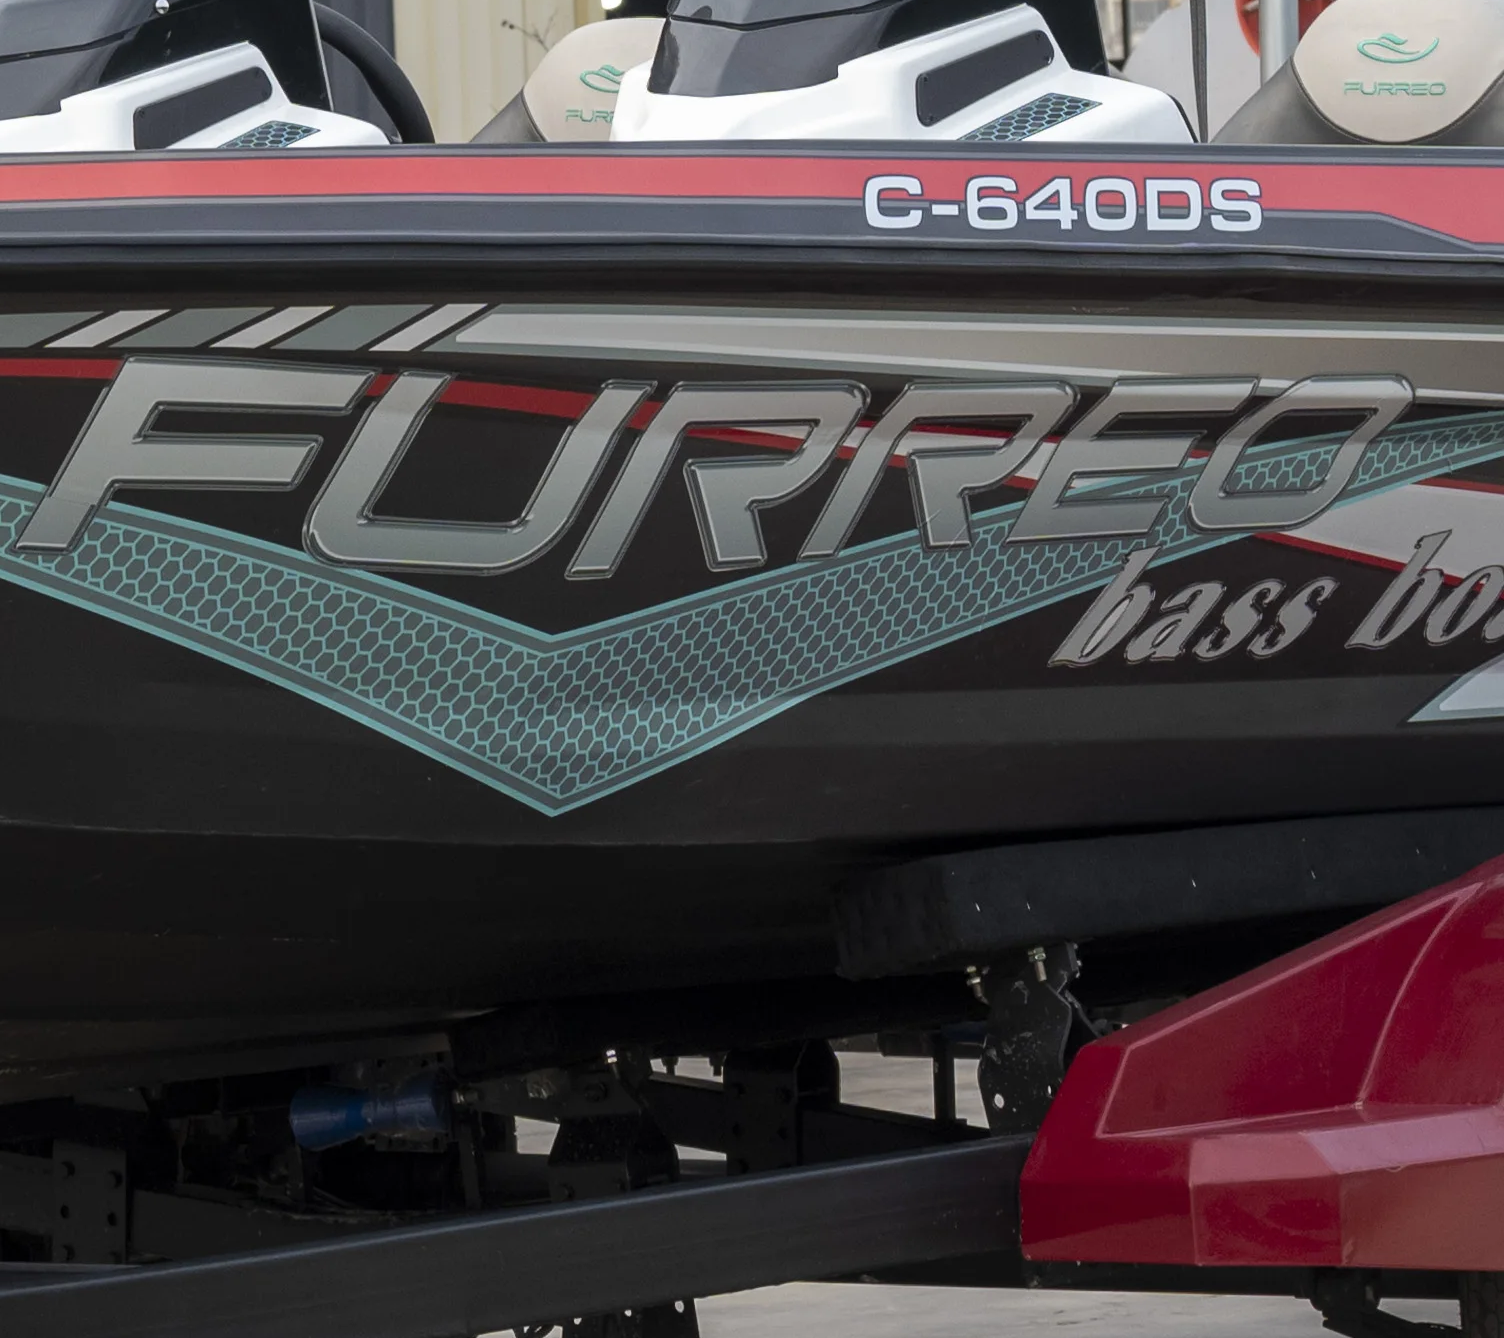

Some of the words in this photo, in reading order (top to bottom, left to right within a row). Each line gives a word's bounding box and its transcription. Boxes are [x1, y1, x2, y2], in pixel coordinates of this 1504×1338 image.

[565, 109, 615, 124] FUR
[1344, 81, 1447, 96] FURREO
[863, 174, 1264, 233] C-640DS
[12, 354, 1416, 579] FURREO
[1047, 544, 1340, 668] bass
